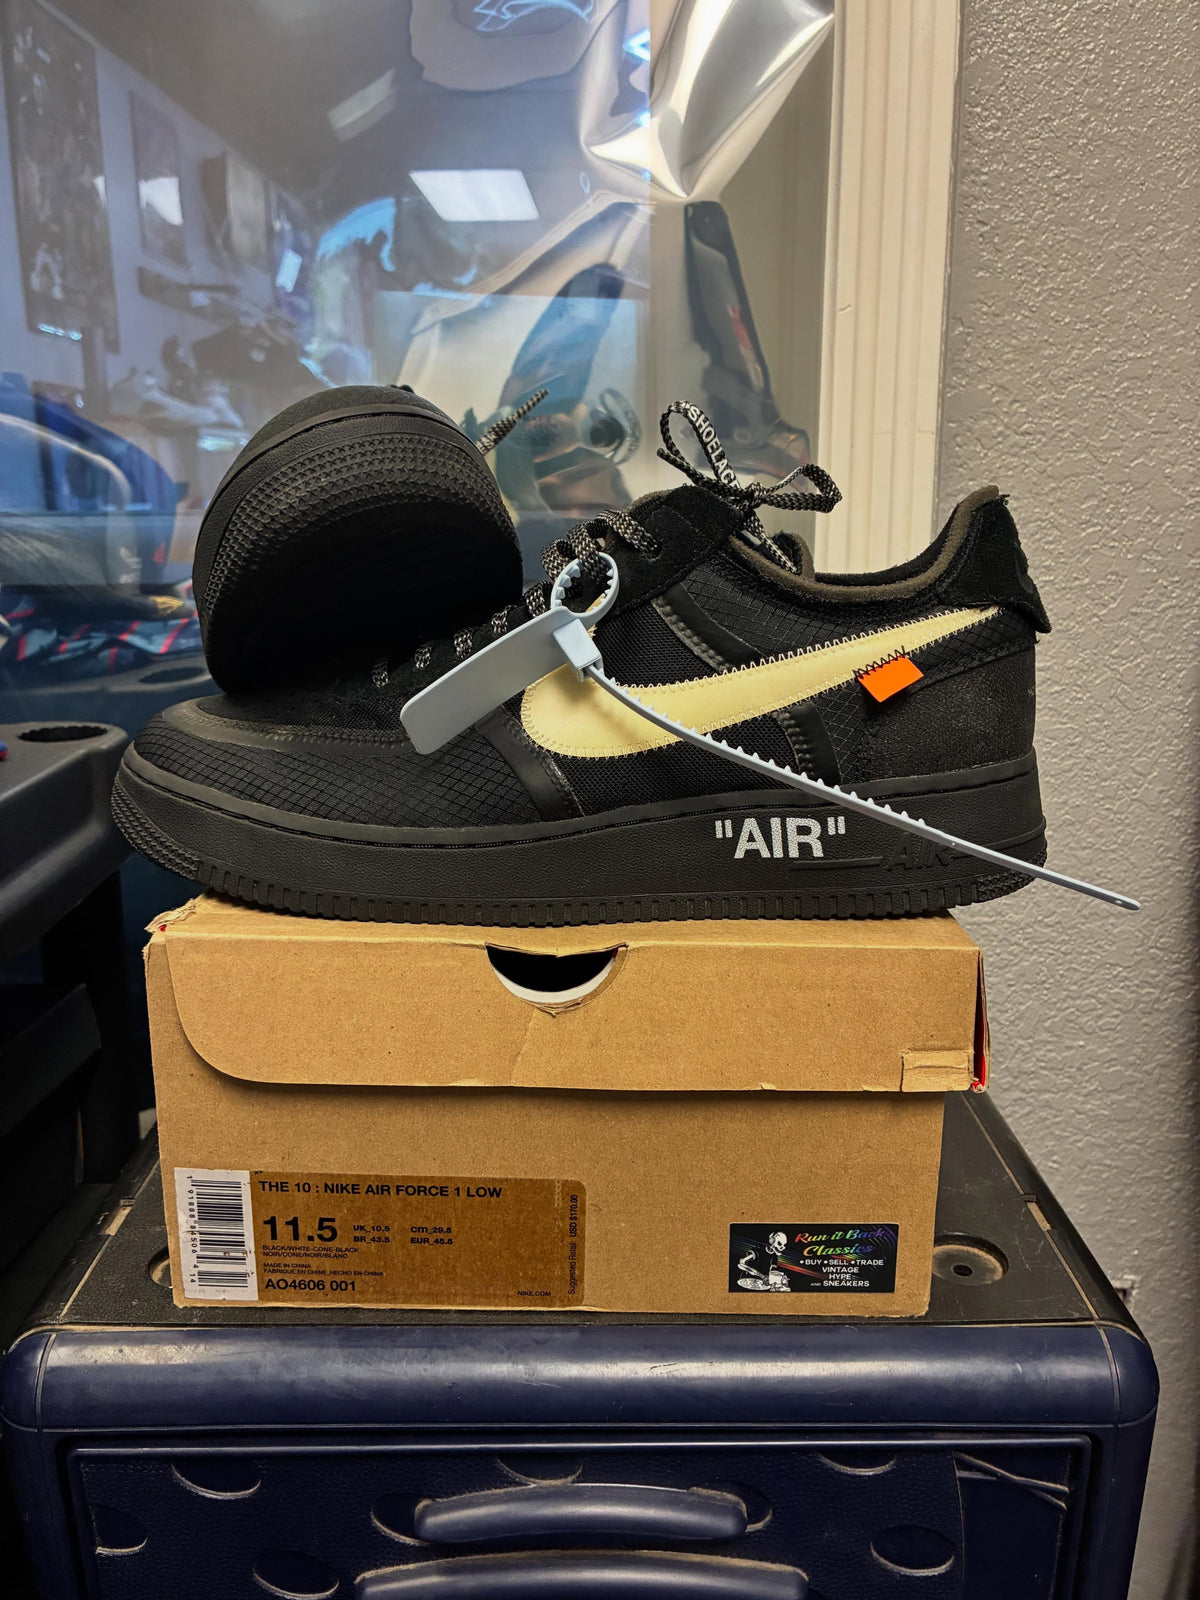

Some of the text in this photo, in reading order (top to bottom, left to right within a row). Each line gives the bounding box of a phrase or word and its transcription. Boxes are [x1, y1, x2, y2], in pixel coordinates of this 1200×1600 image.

[258, 1181, 290, 1193] THE
[294, 1182, 311, 1193] 10
[324, 1183, 361, 1194] NIKE
[365, 1184, 391, 1195] AIR
[396, 1185, 449, 1197] FORCE
[454, 1187, 461, 1197] 1
[466, 1187, 502, 1198] LOW
[569, 1194, 578, 1221] $170.00
[263, 1216, 338, 1242] 11.5
[353, 1225, 390, 1233] UK_10.5
[569, 1222, 577, 1238] USD
[794, 1228, 886, 1243] Run it Back
[353, 1236, 390, 1244] BR_43.5
[803, 1243, 874, 1256] Classics
[330, 1280, 356, 1291] 001
[568, 1262, 577, 1295] Suggested
